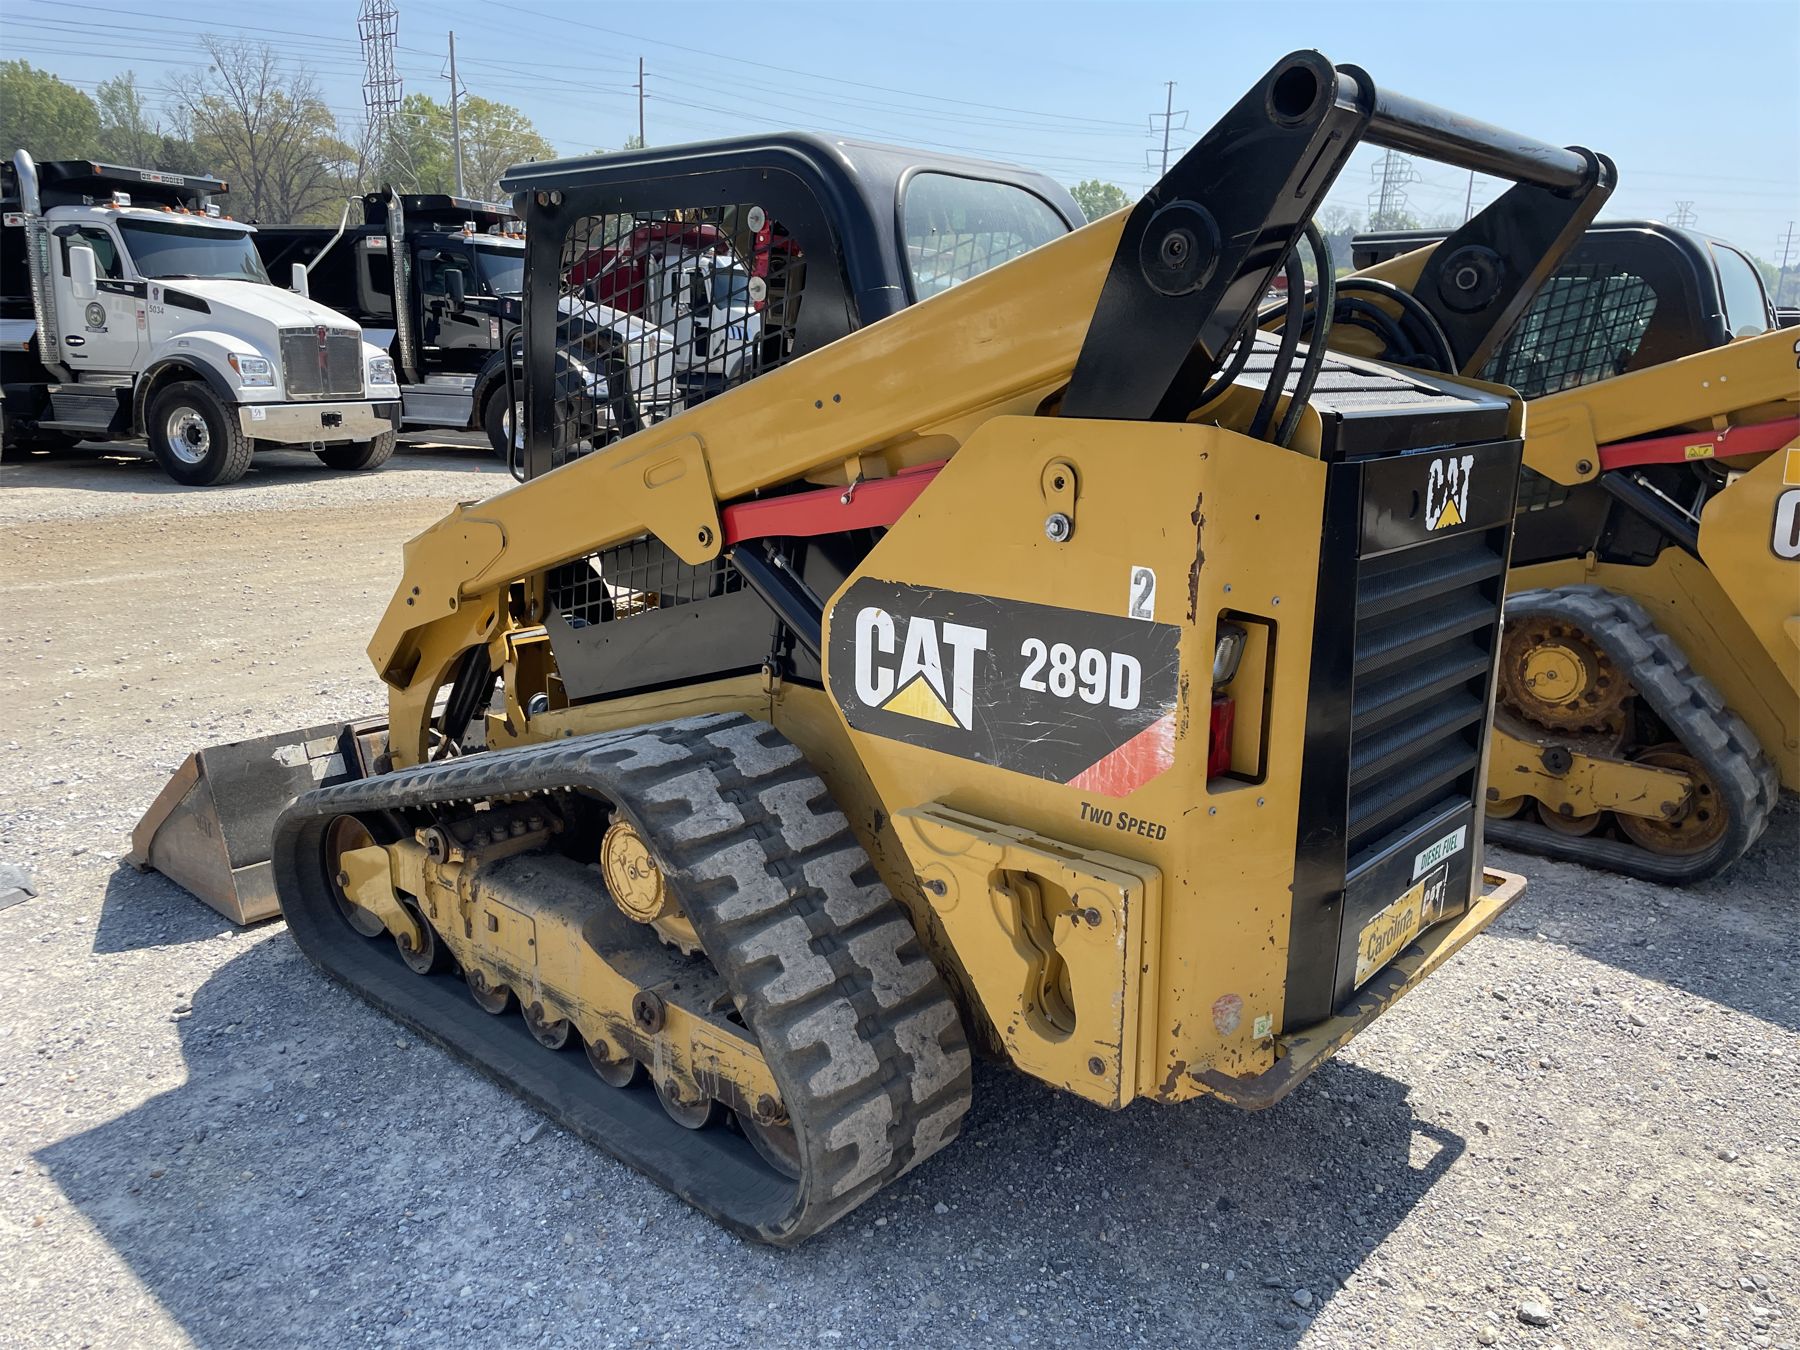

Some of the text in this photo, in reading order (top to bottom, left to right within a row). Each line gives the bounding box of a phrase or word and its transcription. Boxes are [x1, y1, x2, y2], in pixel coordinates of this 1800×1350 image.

[149, 304, 164, 315] 5034
[1426, 455, 1474, 531] CAT
[1131, 569, 1154, 619] 2
[855, 606, 988, 731] CAT
[1019, 637, 1142, 711] 289D
[1421, 834, 1458, 871] DIESEL FUEL
[1367, 908, 1413, 961] Carolina
